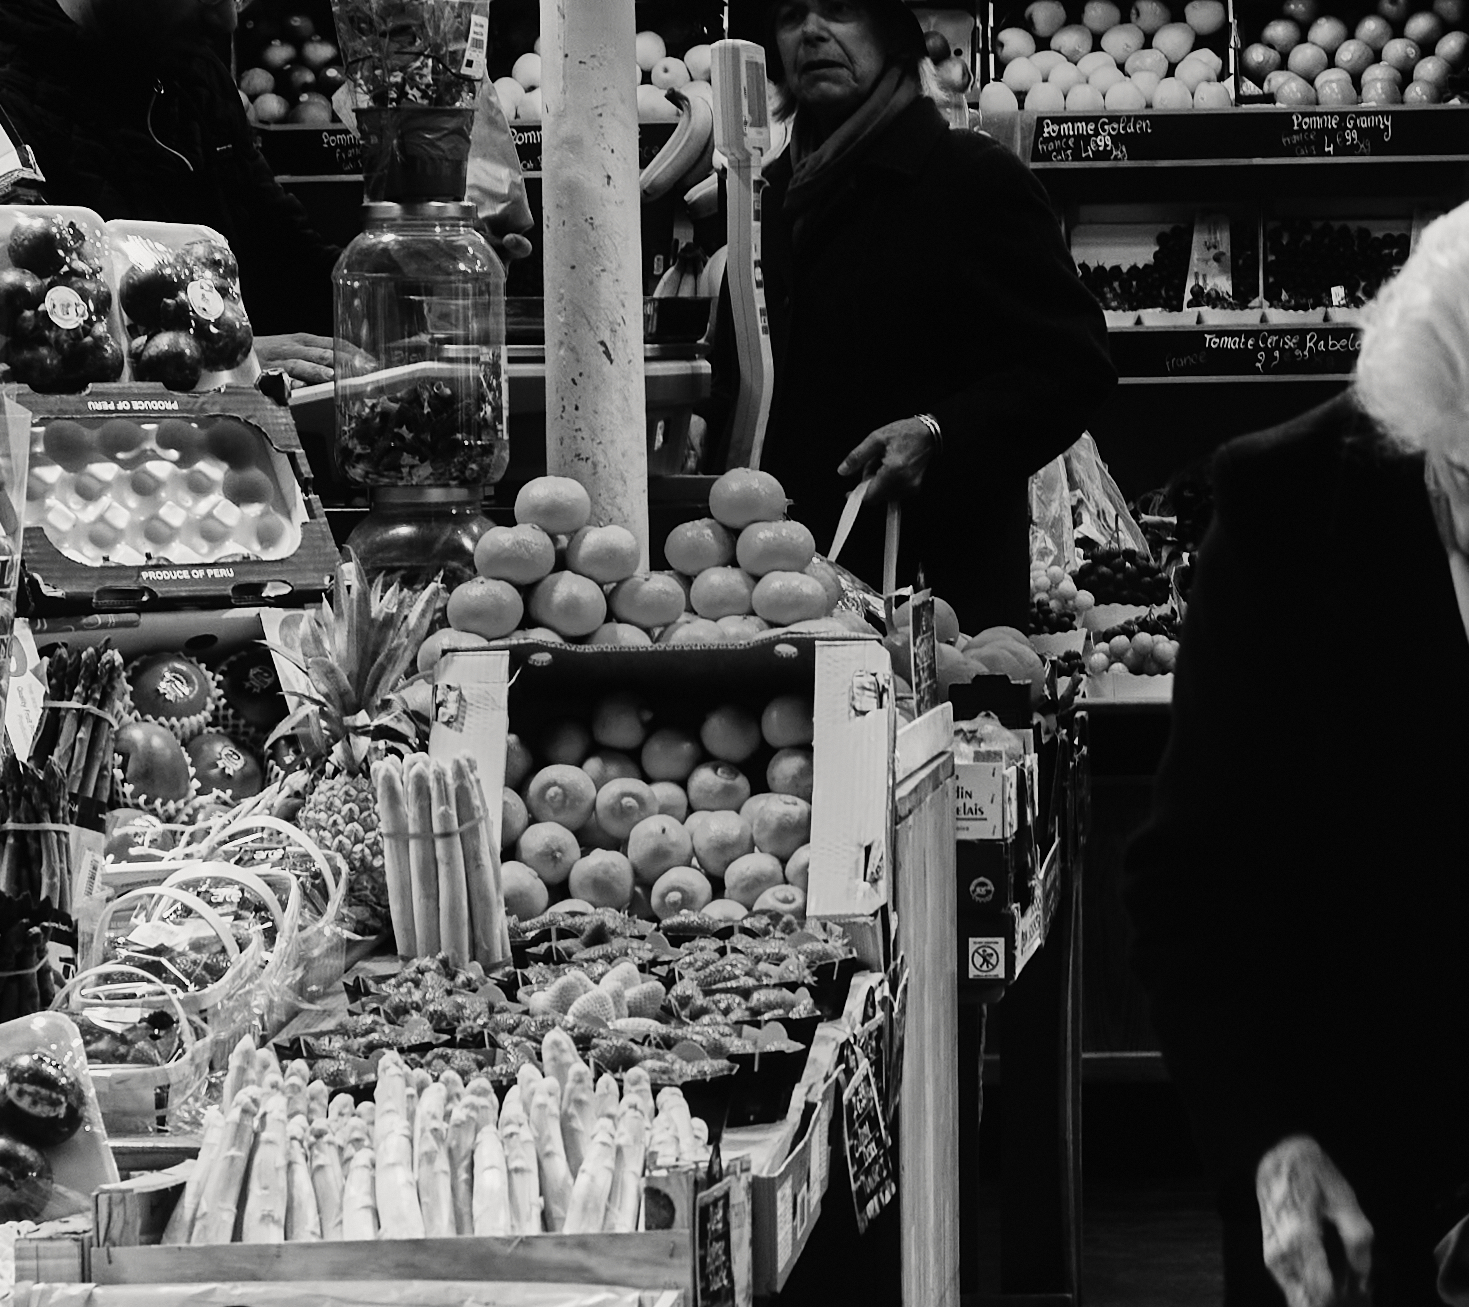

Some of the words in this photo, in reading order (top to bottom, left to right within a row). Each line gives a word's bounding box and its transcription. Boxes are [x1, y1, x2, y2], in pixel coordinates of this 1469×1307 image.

[1042, 117, 1096, 139] Pomme
[1097, 115, 1153, 137] Golden
[1291, 113, 1340, 131] Pomme
[1203, 332, 1256, 350] Tomate
[140, 569, 192, 581] PRODUCE
[191, 568, 206, 579] OF
